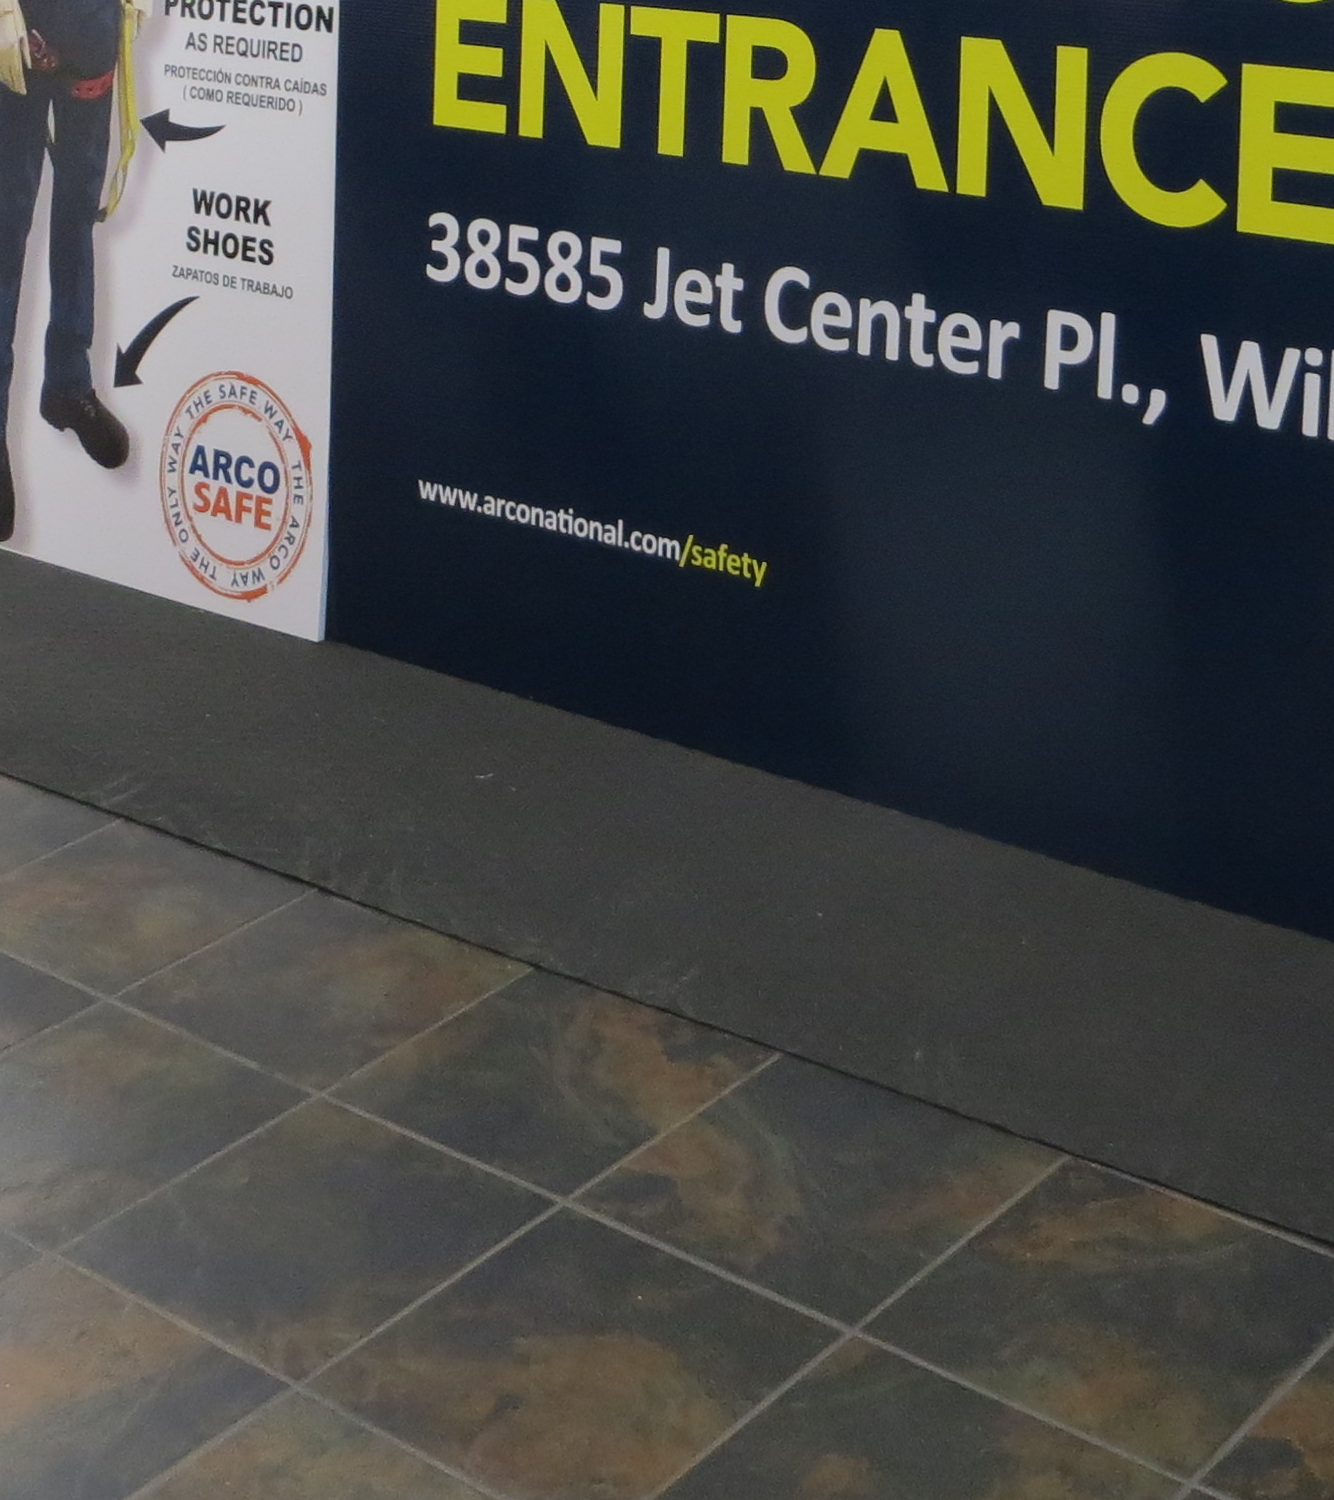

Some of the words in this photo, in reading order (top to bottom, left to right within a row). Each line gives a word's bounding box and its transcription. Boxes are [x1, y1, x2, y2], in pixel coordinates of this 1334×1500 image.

[185, 32, 208, 53] AS
[213, 34, 304, 63] REQUIRED
[164, 64, 232, 86] PROTECCIÓN
[234, 72, 282, 92] CONTRA
[283, 76, 328, 97] CAÍDAS
[189, 86, 224, 104] COMO
[226, 90, 297, 114] REQUERIDO
[192, 187, 273, 227] WORK
[186, 225, 275, 266] SHOES
[171, 265, 220, 287] ZAPATOS
[222, 274, 238, 290] DE
[240, 277, 294, 300] TRABAJO
[425, 211, 624, 311] 38585
[643, 245, 743, 334] Jet
[763, 265, 1020, 381] Center
[1043, 308, 1169, 426] Pl.,
[185, 389, 213, 420] THE
[218, 383, 258, 406] SAFE
[264, 400, 293, 442] WAY
[167, 426, 185, 474] WAY
[188, 444, 281, 495] ARCO
[291, 460, 304, 506] THE
[167, 486, 189, 544] ONLY
[192, 481, 273, 532] SAFE
[269, 515, 300, 571] ARCO
[417, 478, 768, 588] www.arconational.com/safety
[189, 547, 217, 581] THE
[230, 567, 266, 588] WAY
